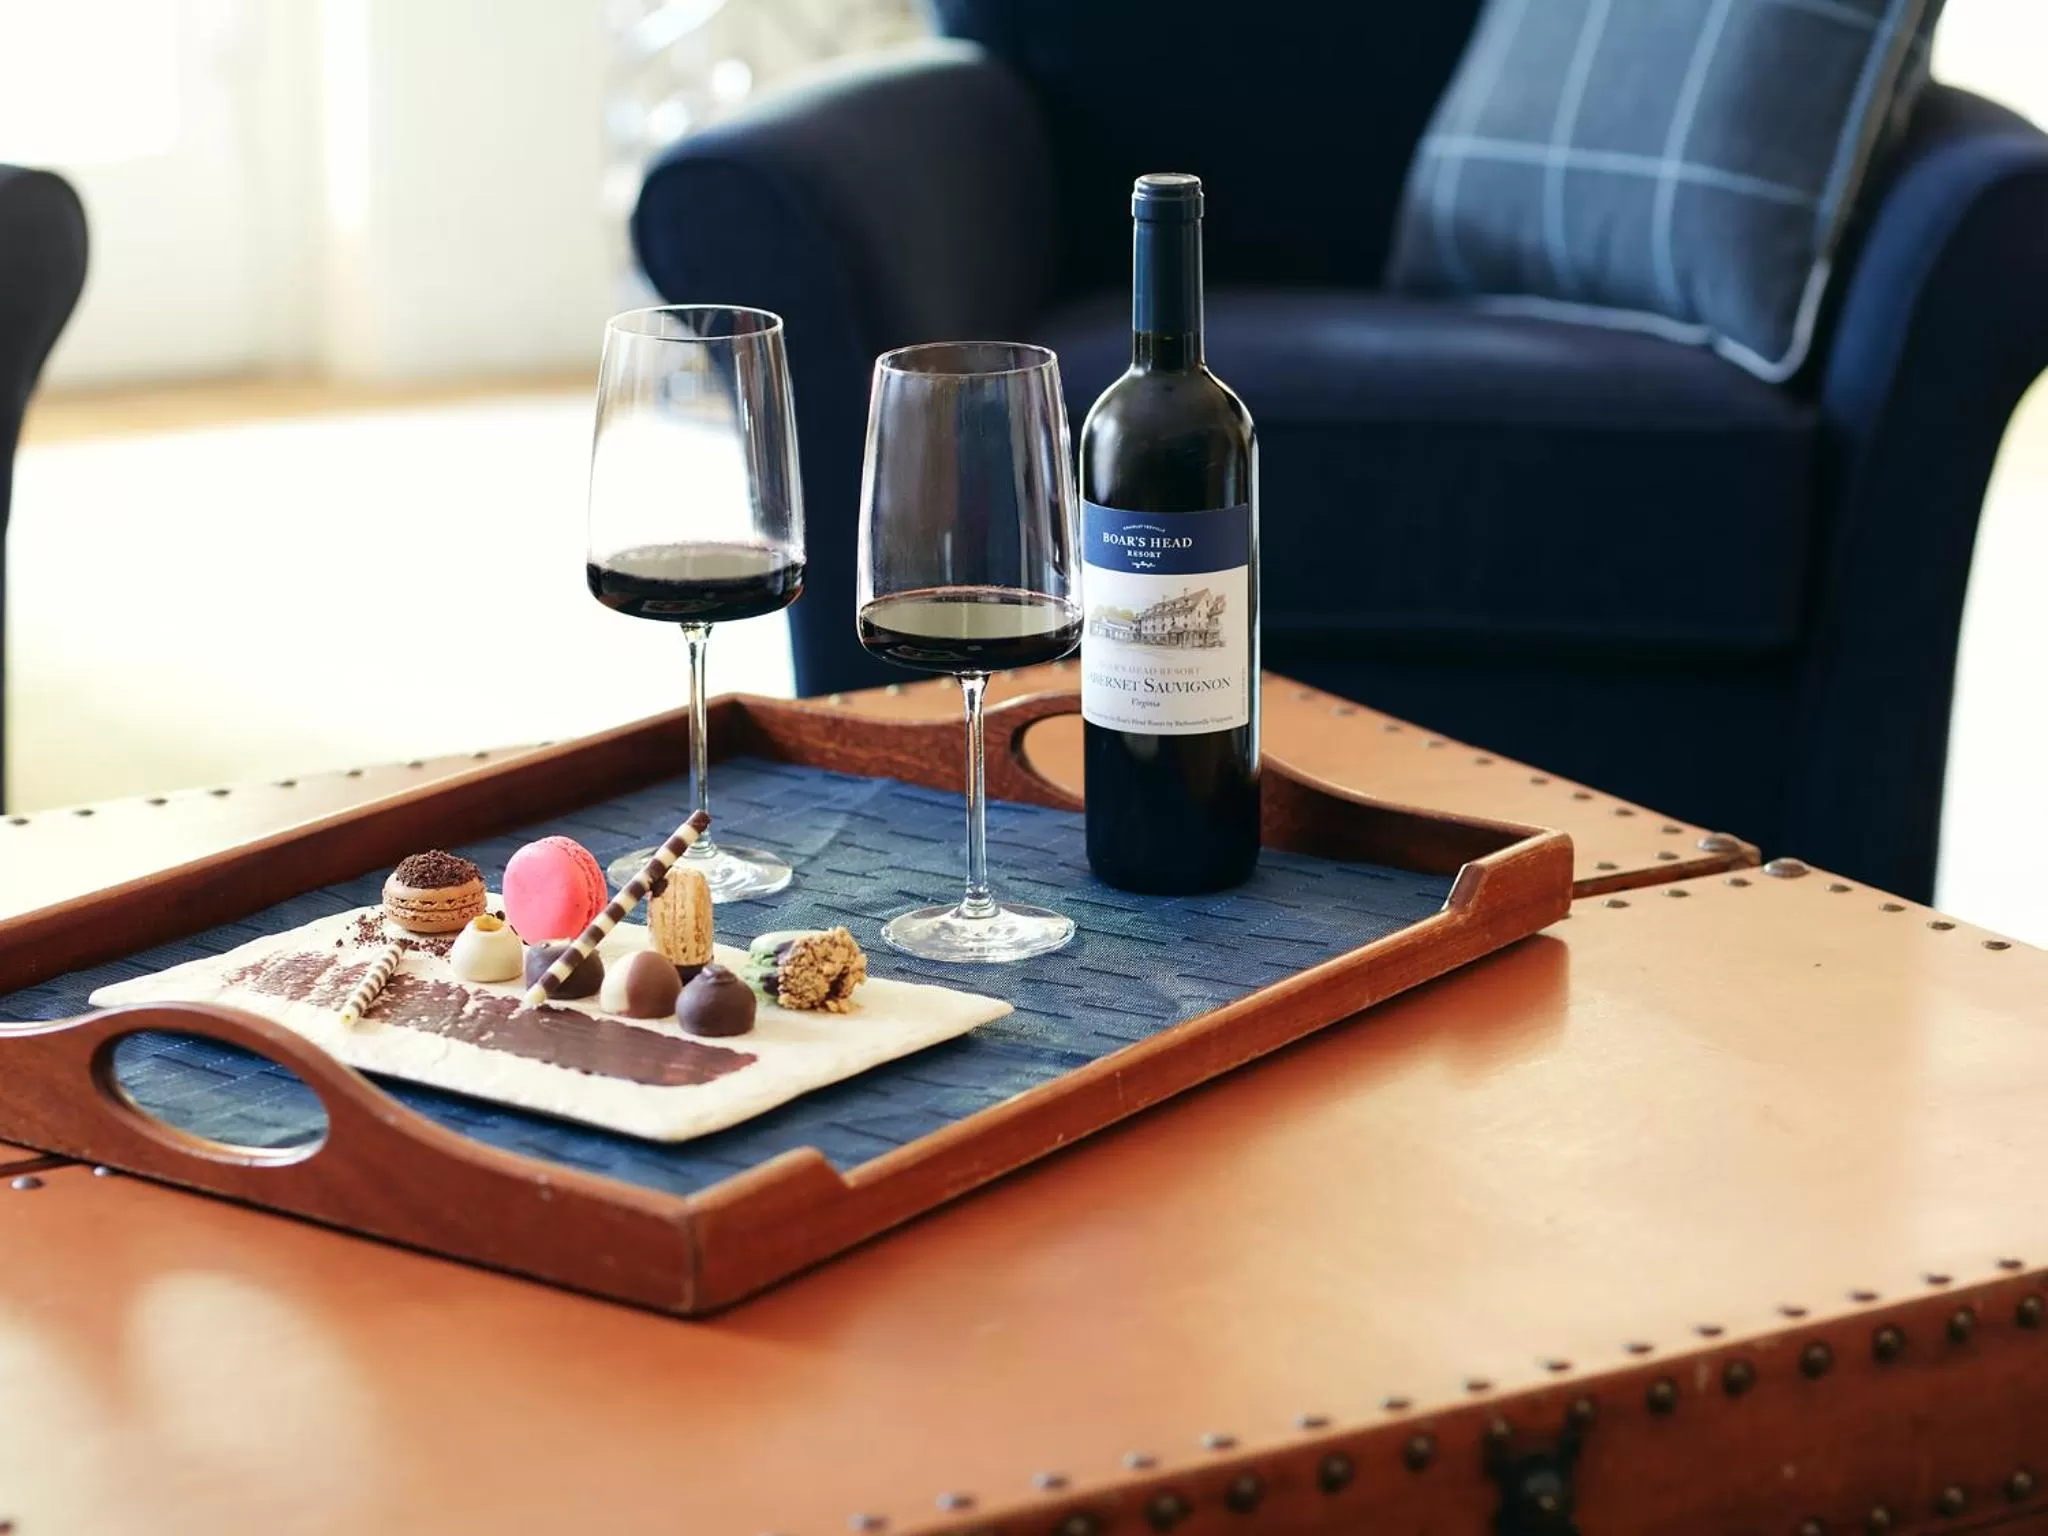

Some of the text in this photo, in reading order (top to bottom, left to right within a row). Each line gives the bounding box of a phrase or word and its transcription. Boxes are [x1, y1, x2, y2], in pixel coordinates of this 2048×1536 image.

[1102, 531, 1193, 548] BOAR'S HEAD
[1127, 550, 1161, 558] RESORT
